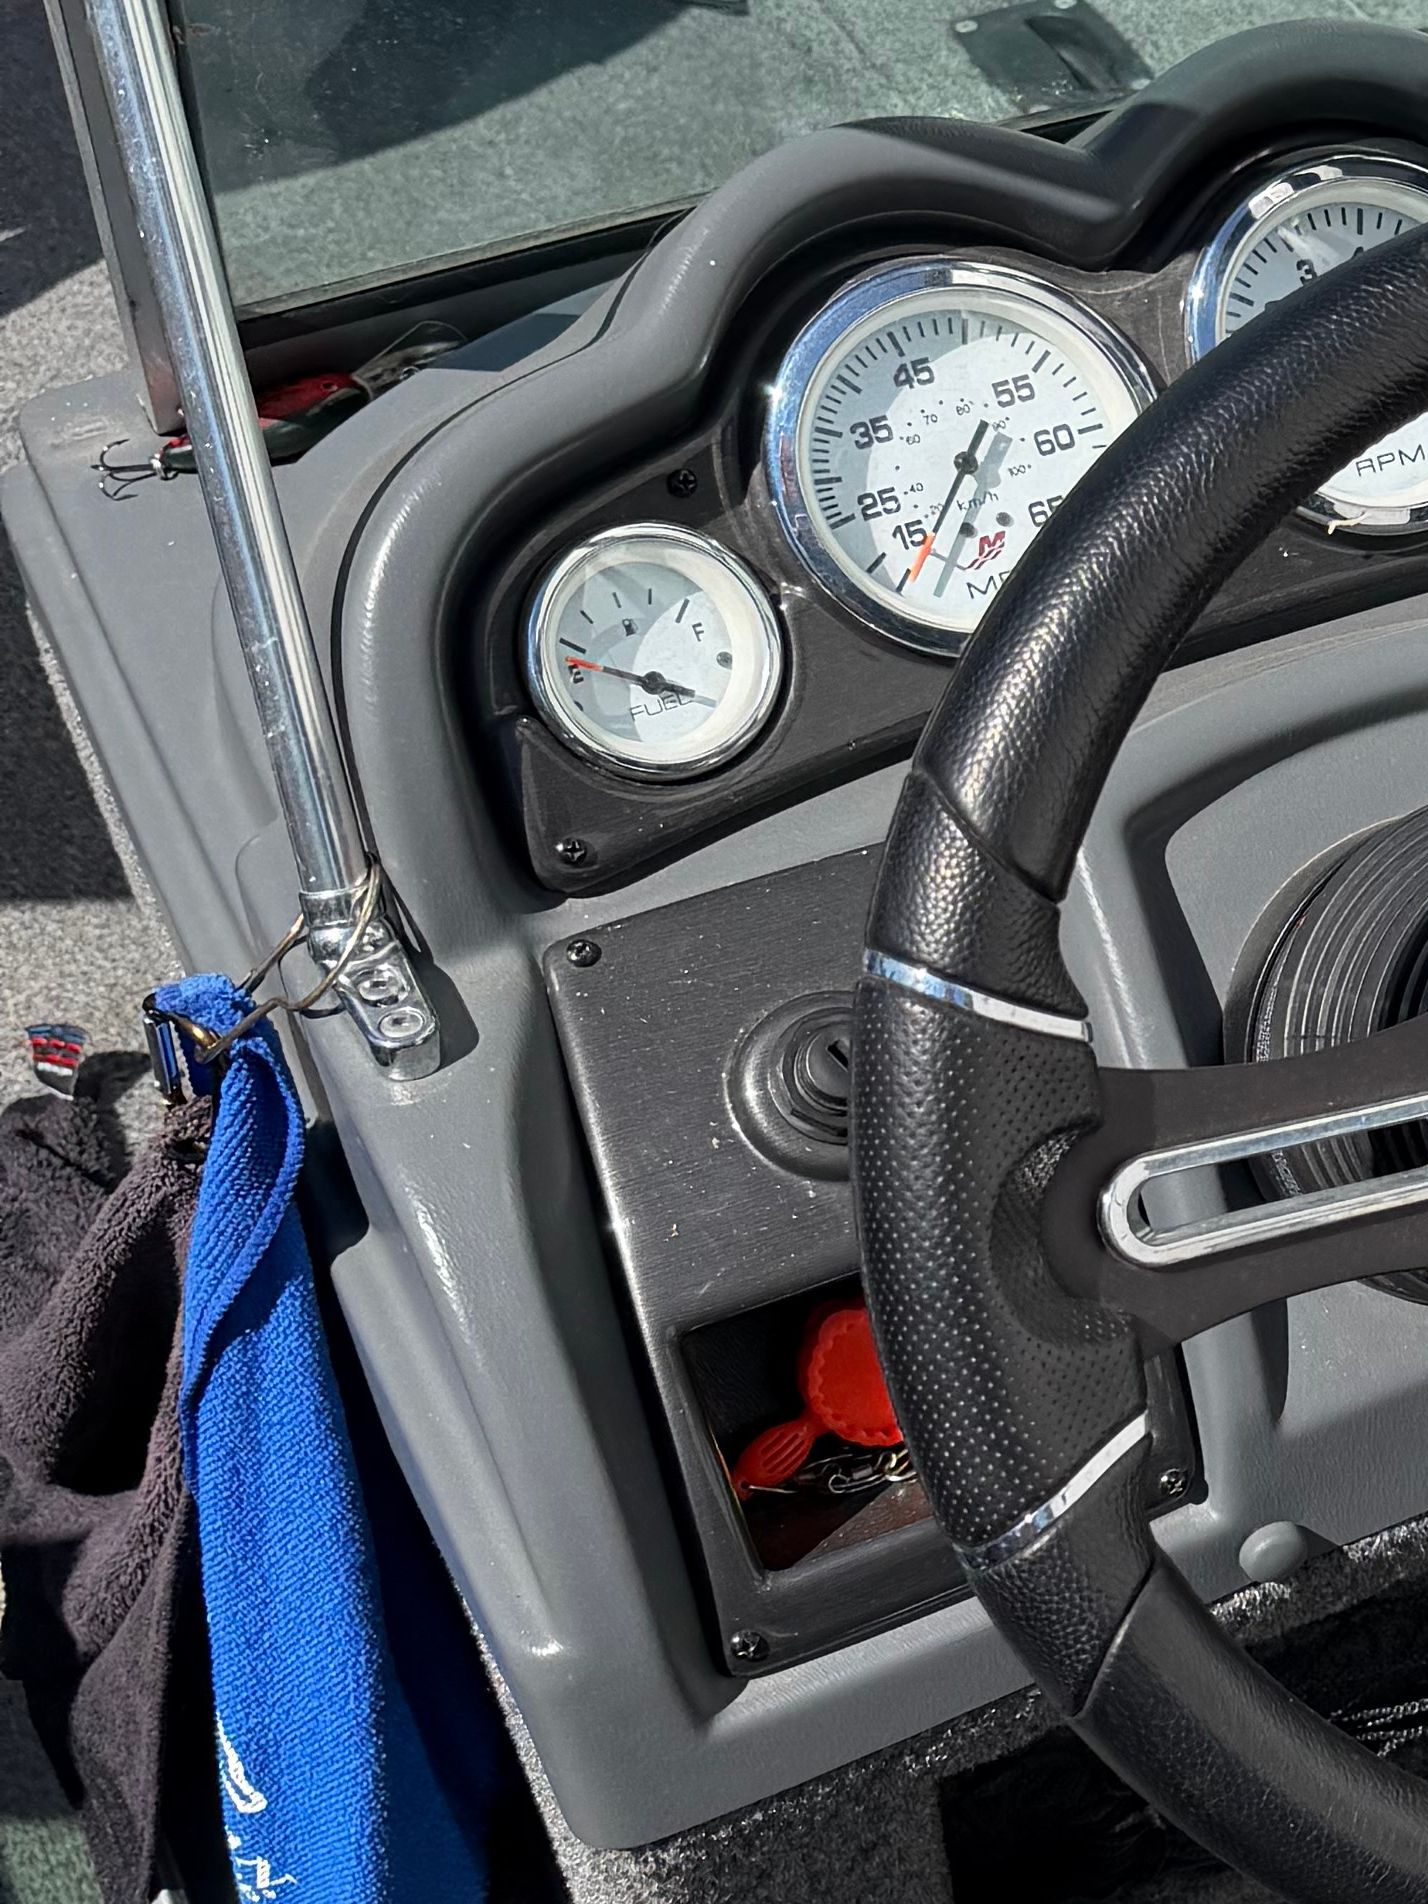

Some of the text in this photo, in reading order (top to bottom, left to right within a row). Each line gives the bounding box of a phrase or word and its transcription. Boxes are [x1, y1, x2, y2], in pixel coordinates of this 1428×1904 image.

[1296, 259, 1319, 286] 3
[893, 357, 935, 390] 45
[991, 374, 1035, 409] 55
[850, 415, 893, 450] 35
[922, 413, 938, 425] 70
[1033, 423, 1075, 456] 60
[1355, 444, 1426, 477] RPM
[857, 487, 901, 521] 25
[892, 519, 929, 551] 15
[692, 623, 705, 642] F
[630, 690, 693, 722] FUEL
